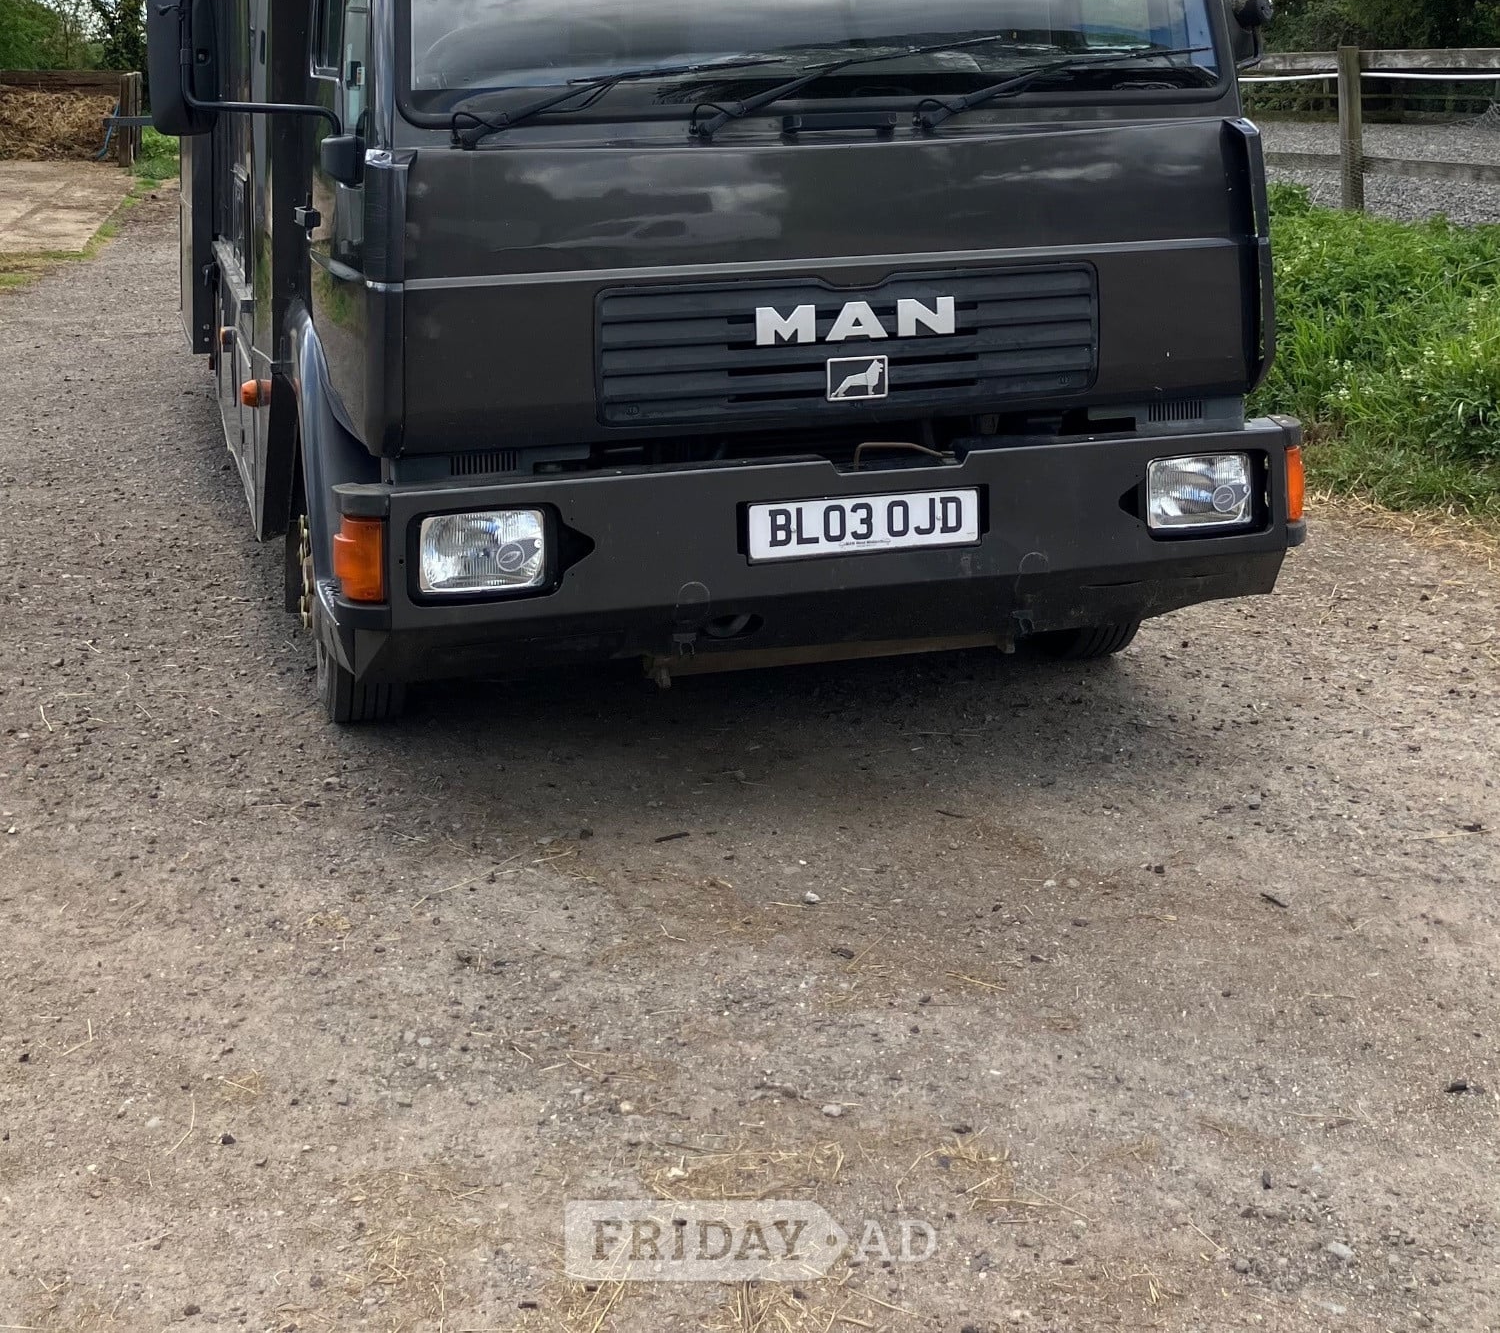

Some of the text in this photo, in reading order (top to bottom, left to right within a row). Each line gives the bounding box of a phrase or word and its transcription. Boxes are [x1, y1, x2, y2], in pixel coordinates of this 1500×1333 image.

[755, 296, 956, 346] MAN
[768, 496, 962, 548] BL03 OJD
